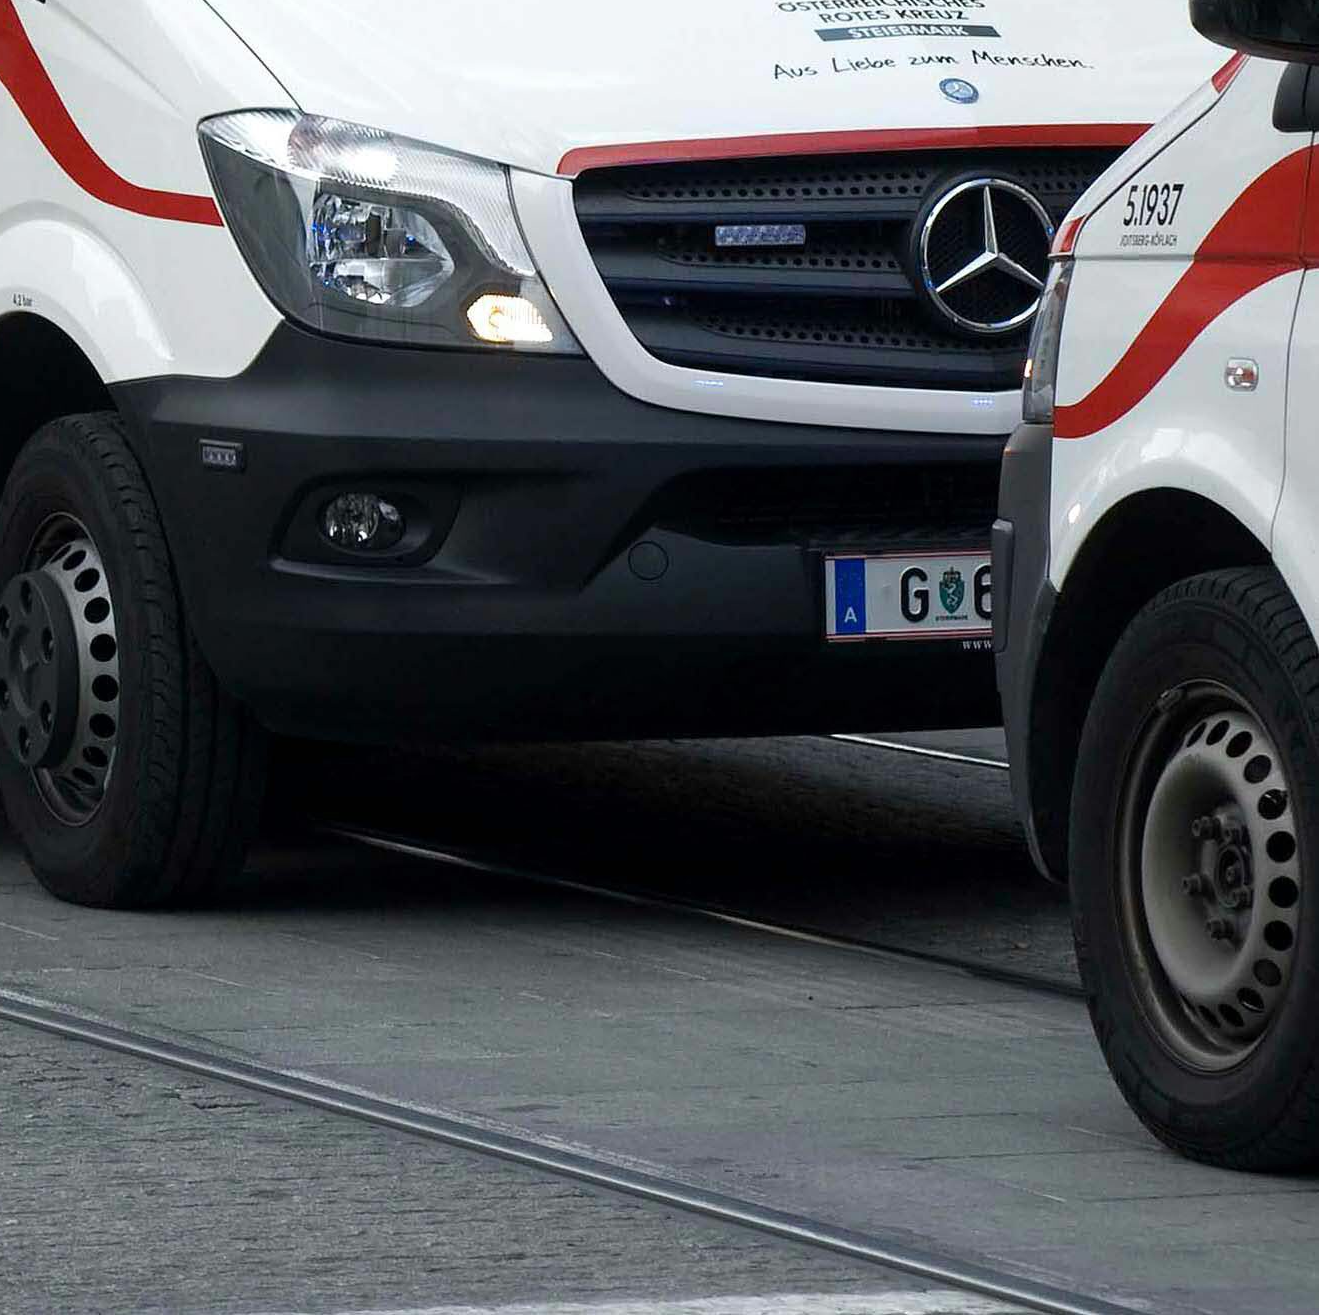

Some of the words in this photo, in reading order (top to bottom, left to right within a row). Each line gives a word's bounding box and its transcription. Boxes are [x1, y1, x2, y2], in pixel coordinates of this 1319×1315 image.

[819, 10, 890, 24] ROTES
[895, 9, 970, 21] KREUZ
[849, 26, 970, 38] STEIERMARK
[774, 63, 818, 79] Aus
[831, 57, 895, 73] Liebe
[910, 55, 957, 66] zum
[1123, 183, 1184, 226] 5.1937
[900, 565, 929, 623] G
[844, 606, 858, 623] A
